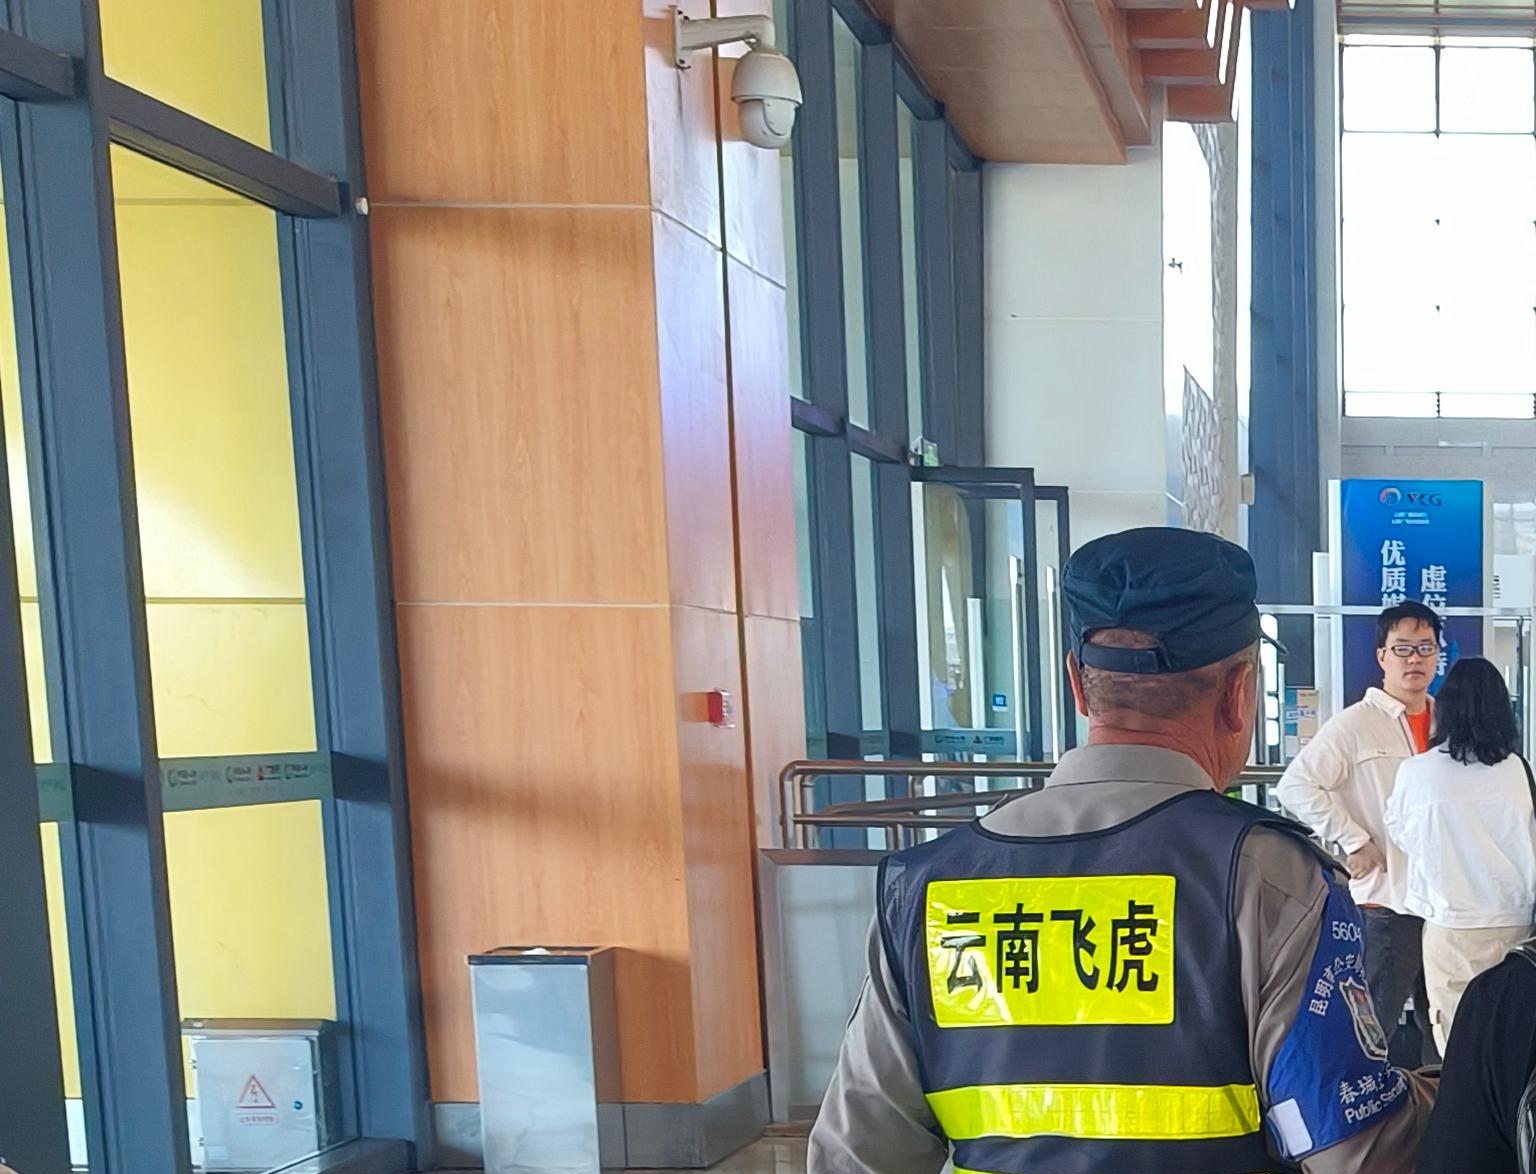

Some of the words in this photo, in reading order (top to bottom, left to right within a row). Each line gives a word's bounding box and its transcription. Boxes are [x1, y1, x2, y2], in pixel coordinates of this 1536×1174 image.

[940, 899, 1160, 994] 云南飞虎
[1344, 1099, 1383, 1124] Public
